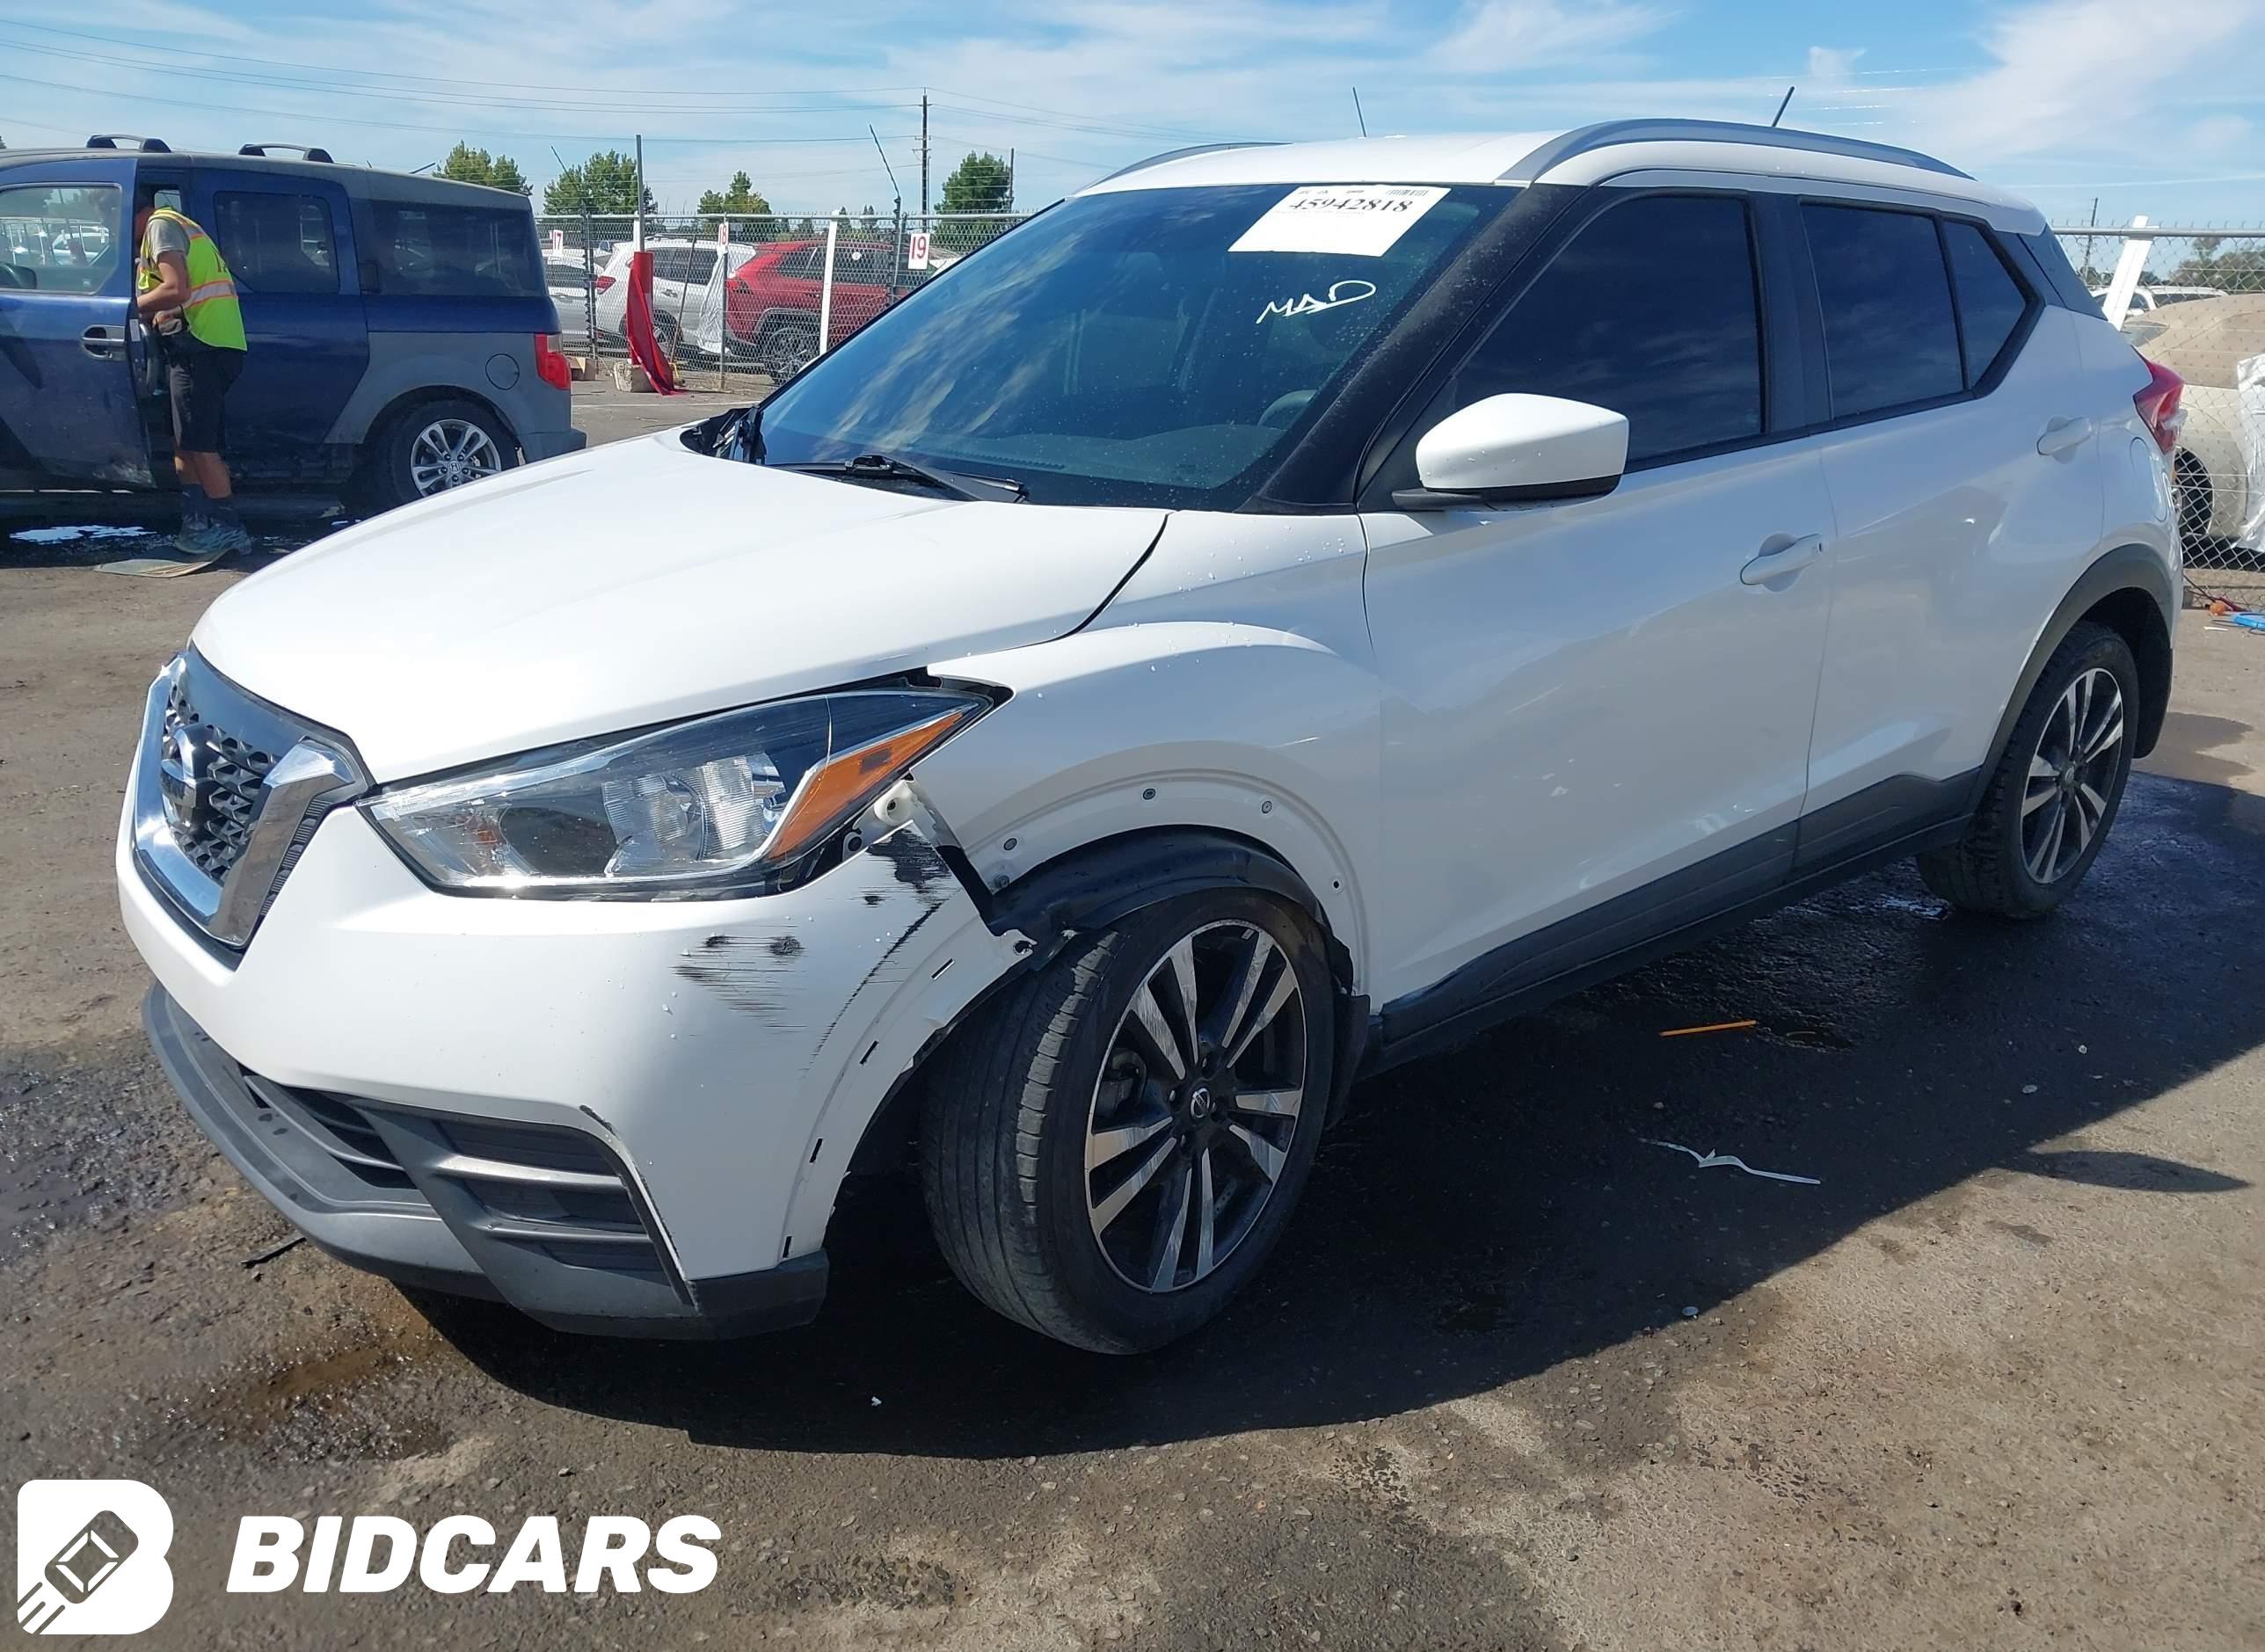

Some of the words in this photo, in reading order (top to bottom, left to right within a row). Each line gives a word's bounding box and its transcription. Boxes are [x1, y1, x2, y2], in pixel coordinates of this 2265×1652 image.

[1289, 198, 1414, 213] 45942818
[718, 224, 727, 247] 18
[911, 236, 927, 259] 19
